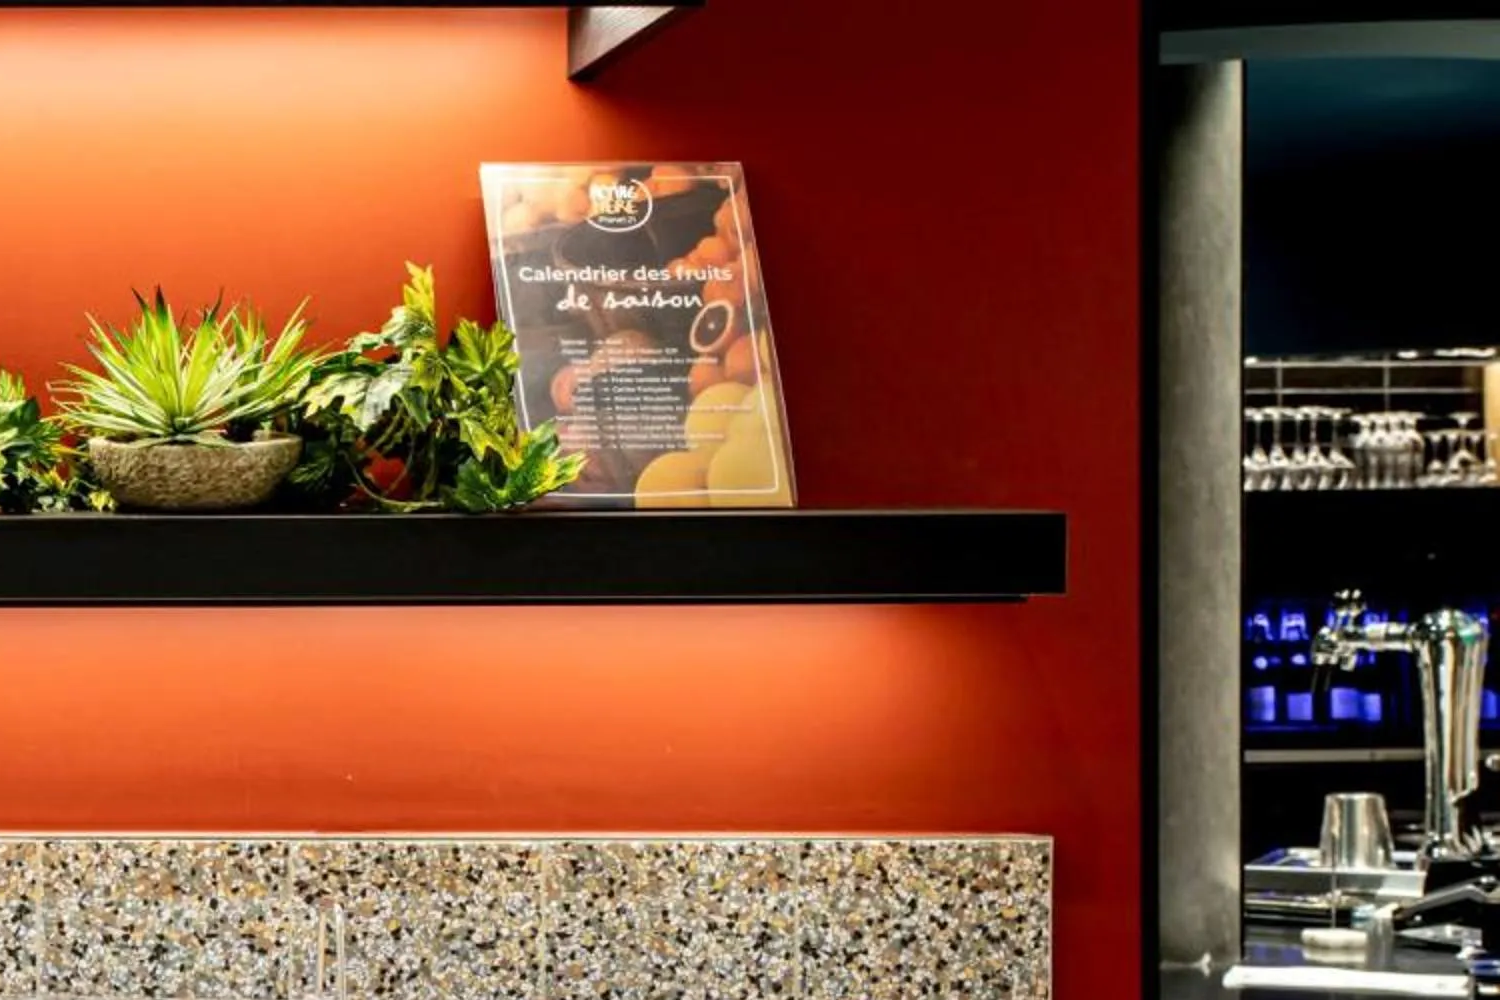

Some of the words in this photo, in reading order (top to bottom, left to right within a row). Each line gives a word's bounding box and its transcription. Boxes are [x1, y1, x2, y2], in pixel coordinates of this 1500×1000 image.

[519, 265, 628, 282] Calendrier
[633, 265, 671, 281] des
[676, 264, 733, 281] fruits
[556, 283, 592, 311] de
[603, 286, 703, 309] saison
